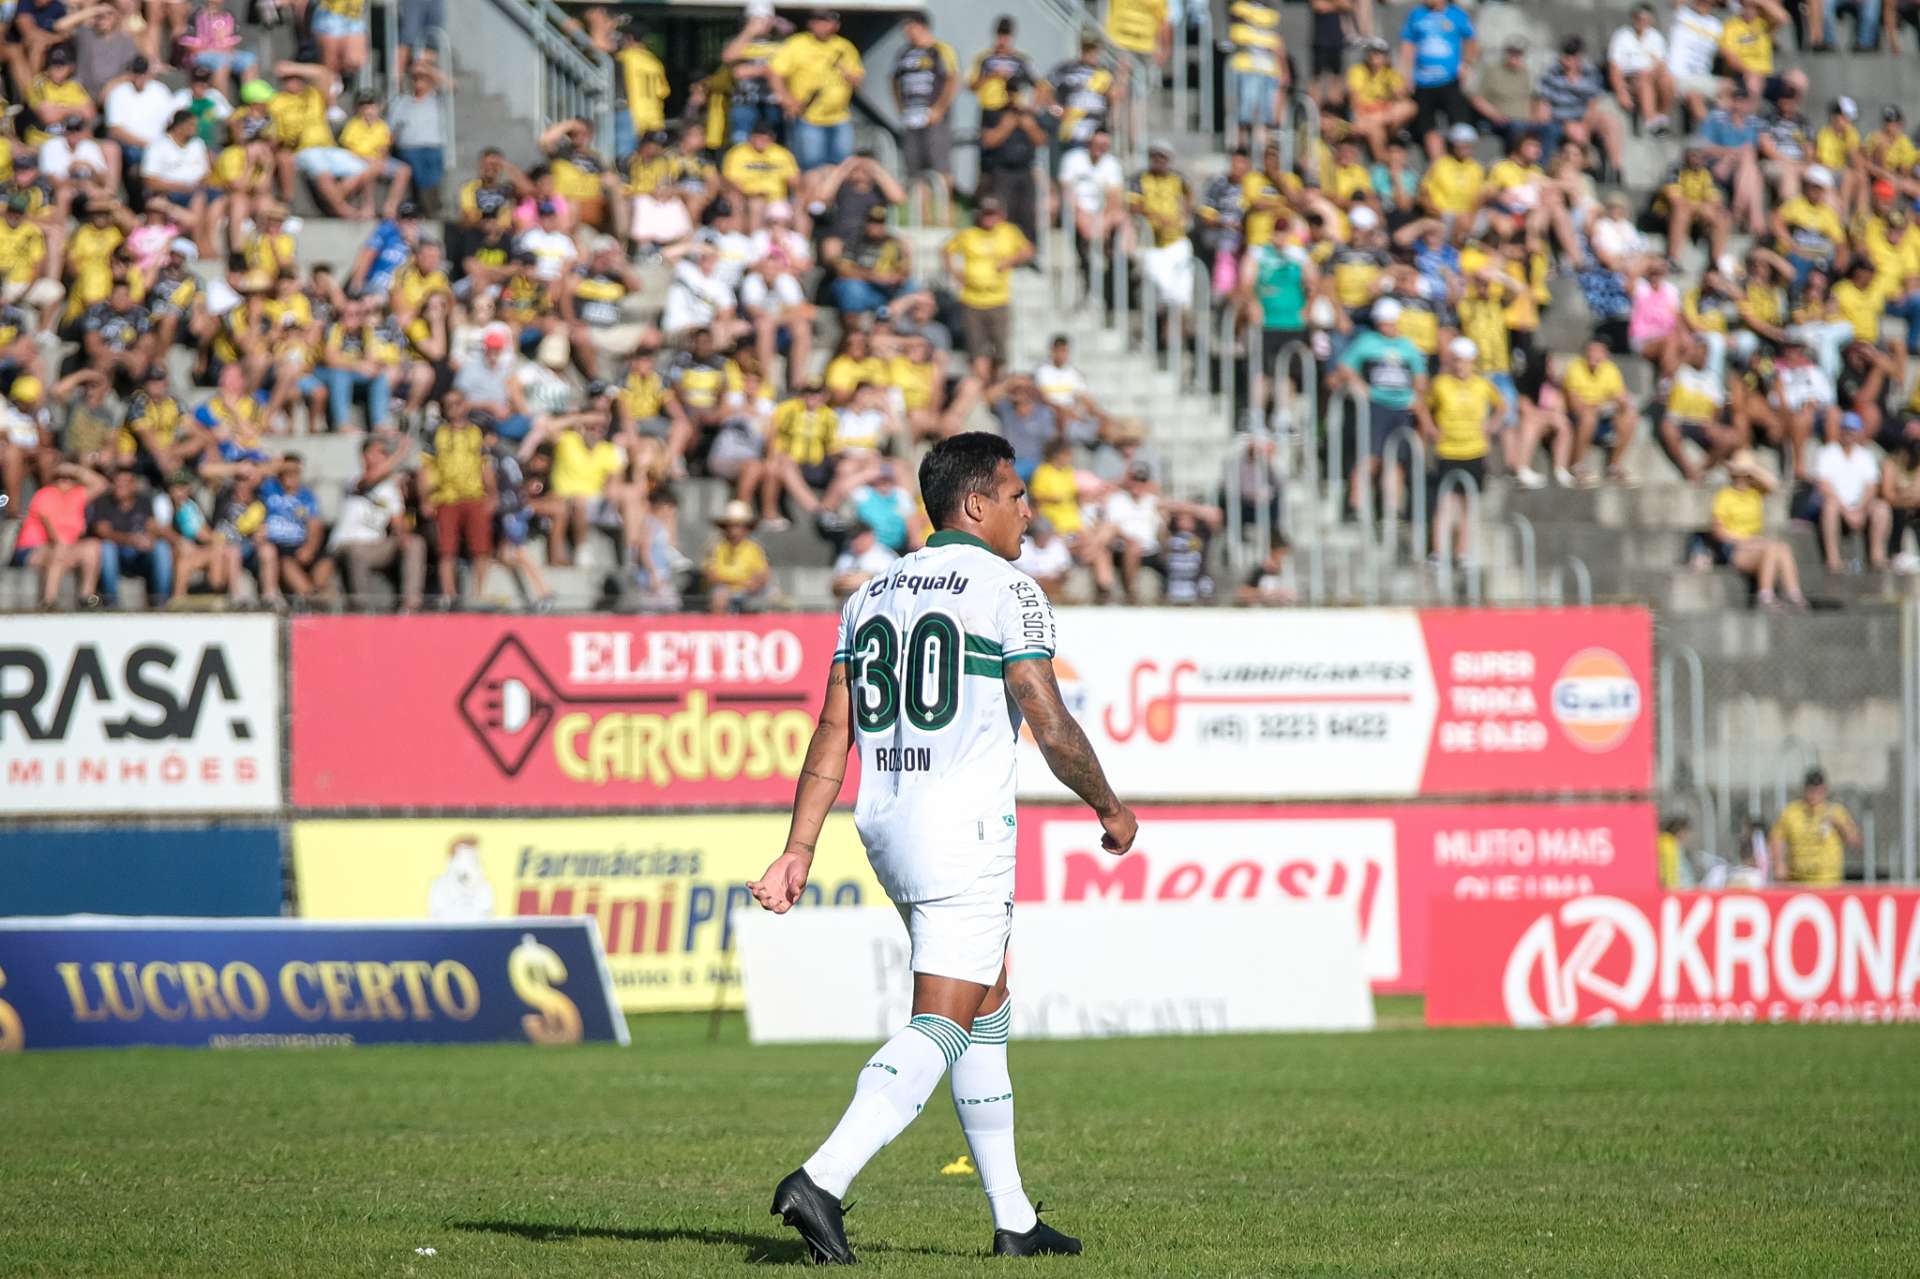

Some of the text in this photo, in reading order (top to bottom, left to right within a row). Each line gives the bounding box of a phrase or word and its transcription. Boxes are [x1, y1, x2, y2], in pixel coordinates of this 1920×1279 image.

[569, 630, 804, 684] ELETRO
[854, 612, 961, 733] 30
[1452, 650, 1536, 682] SUPER
[1450, 686, 1538, 717] TROCA
[1440, 720, 1478, 751] DE
[876, 747, 931, 772] ROON
[518, 847, 704, 879] Farmácias
[1434, 827, 1616, 868] MUITO MAIS
[57, 960, 270, 1021] LUCRO
[279, 959, 481, 1021] CERTO
